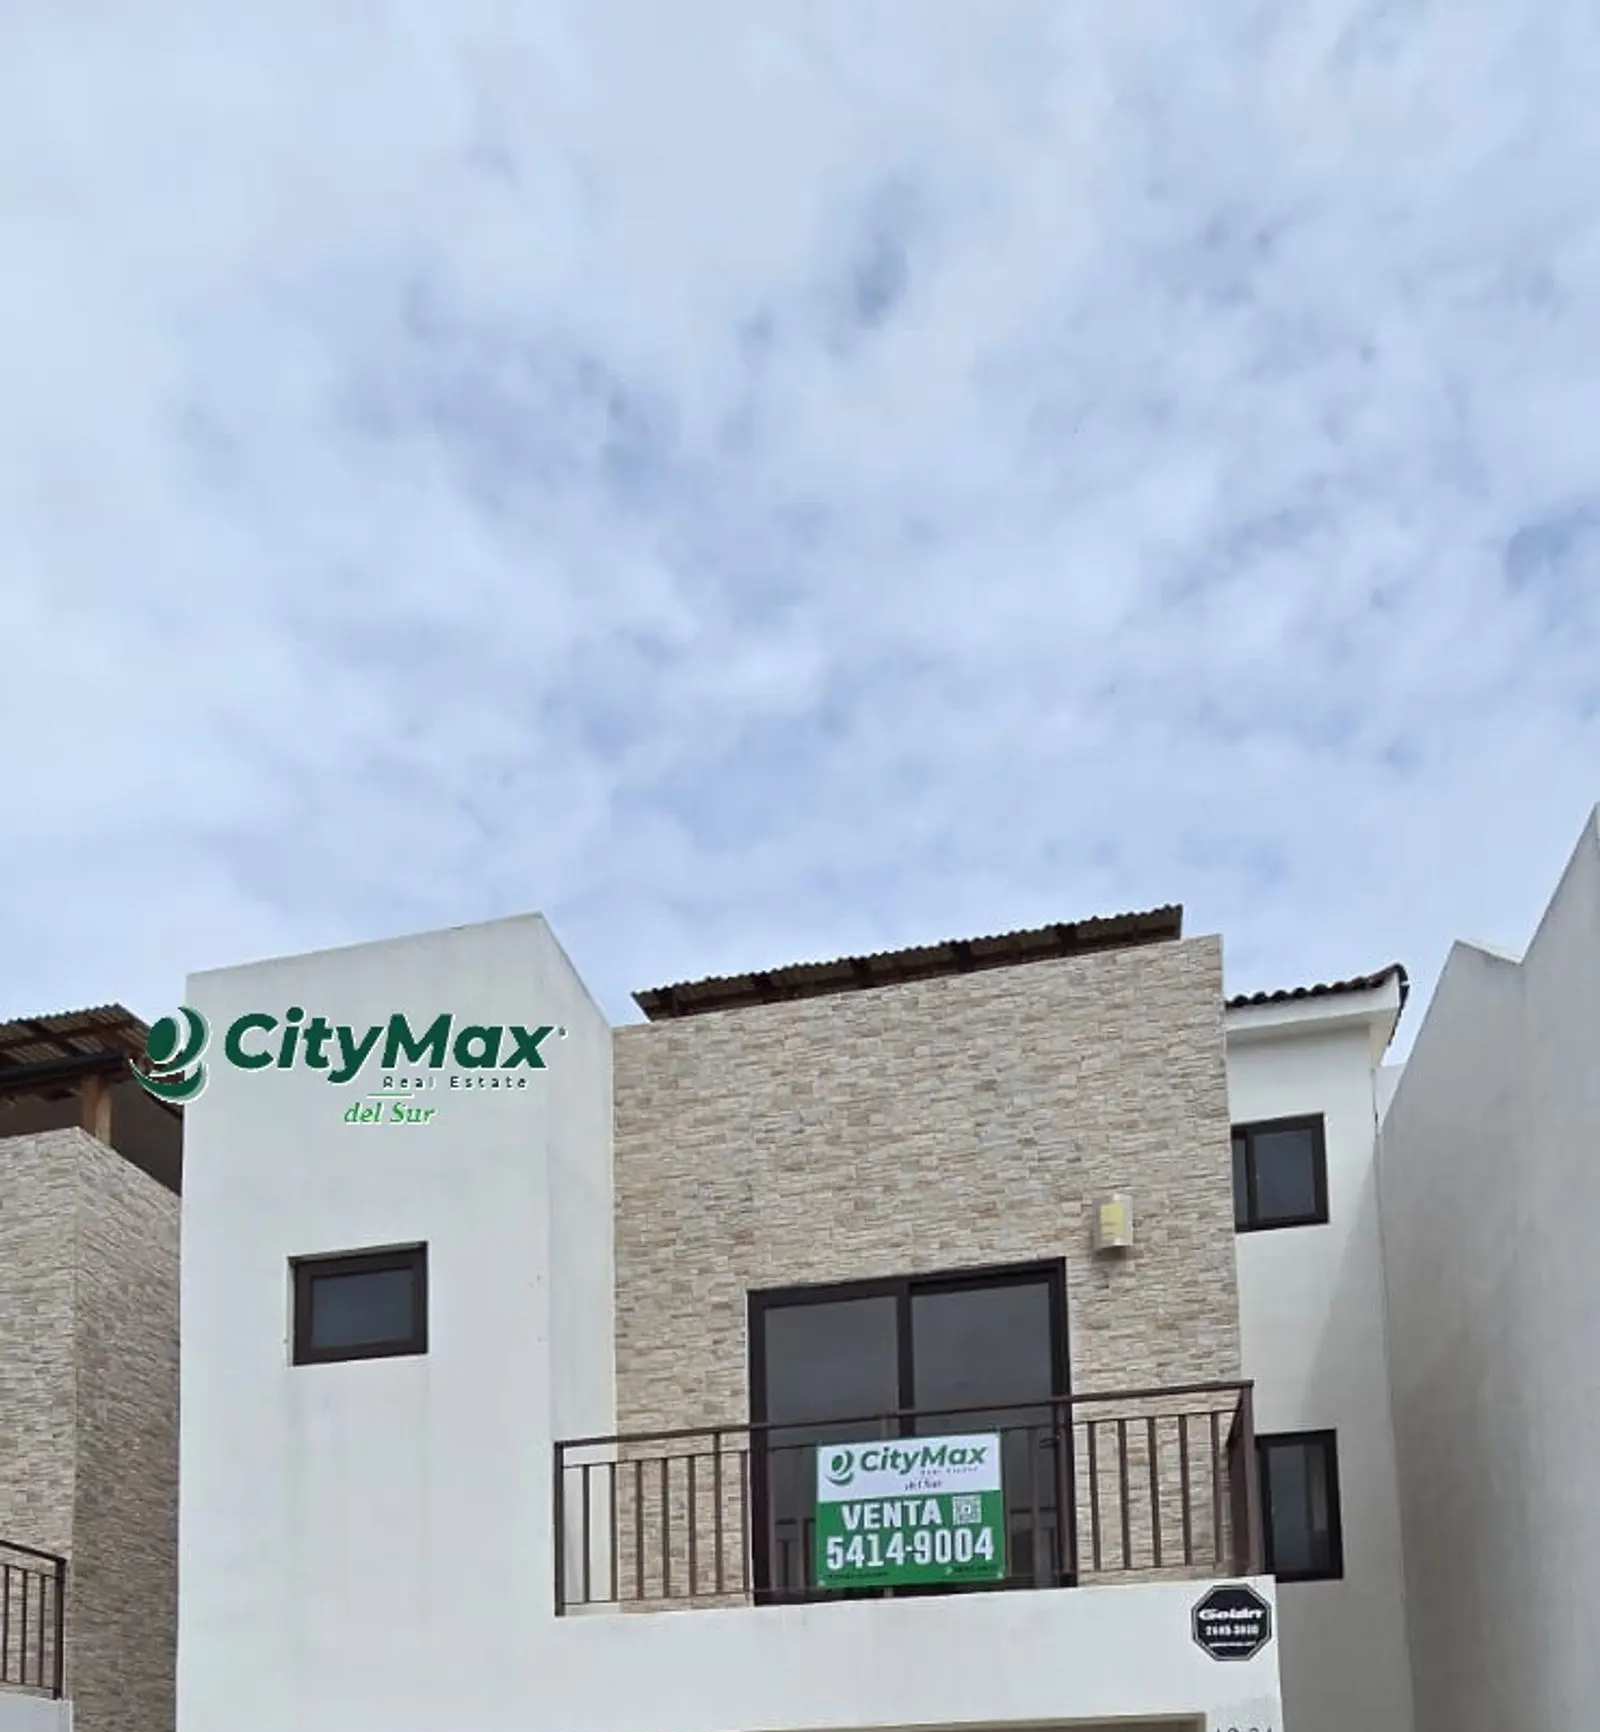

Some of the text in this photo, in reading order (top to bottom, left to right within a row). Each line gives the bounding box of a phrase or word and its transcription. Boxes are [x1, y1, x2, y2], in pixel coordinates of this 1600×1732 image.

[860, 1444, 988, 1475] CityMax
[841, 1498, 942, 1530] VENTA
[826, 1526, 995, 1571] 5414-9004
